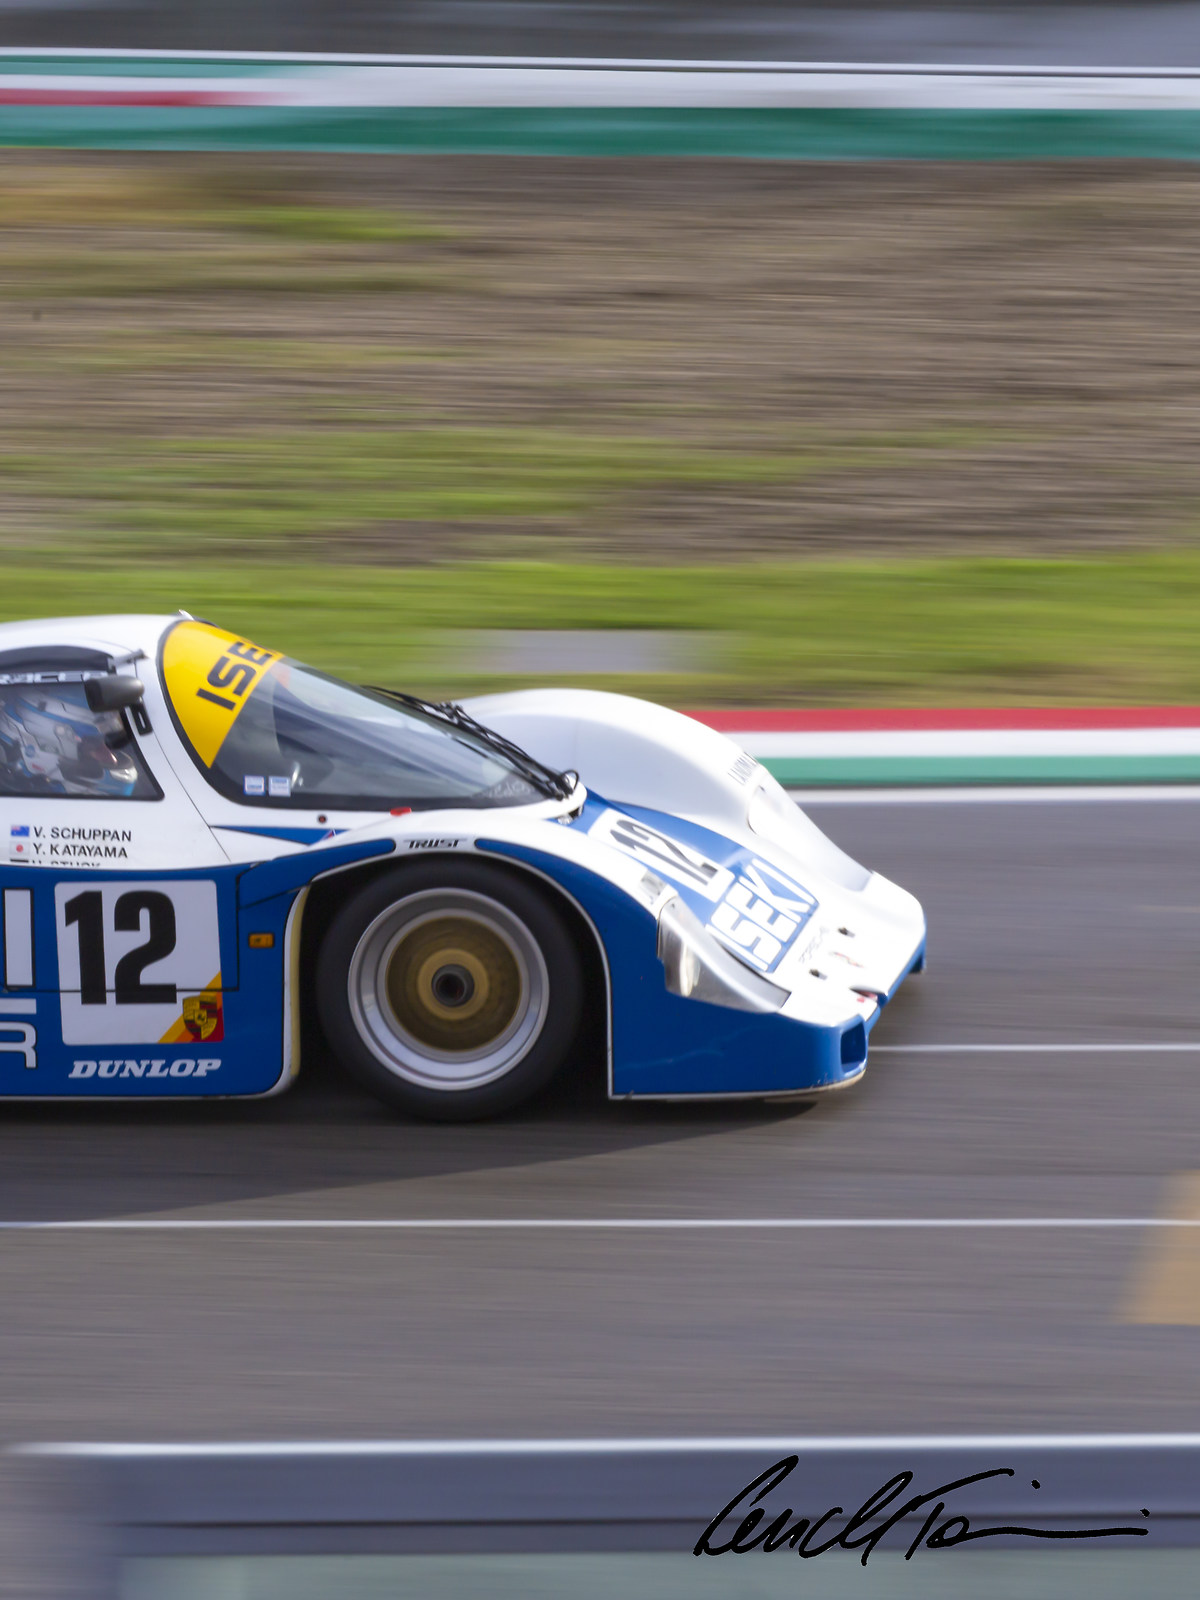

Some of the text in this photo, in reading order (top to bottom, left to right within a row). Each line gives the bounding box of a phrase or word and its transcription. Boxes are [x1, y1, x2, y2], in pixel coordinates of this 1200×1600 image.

[32, 843, 128, 859] Y. KATAYAMA
[33, 826, 132, 842] V. SCHUPPAN
[610, 819, 718, 886] 12
[705, 858, 814, 973] ISEKI
[65, 890, 177, 1005] 12
[68, 1059, 221, 1078] DUNLOP
